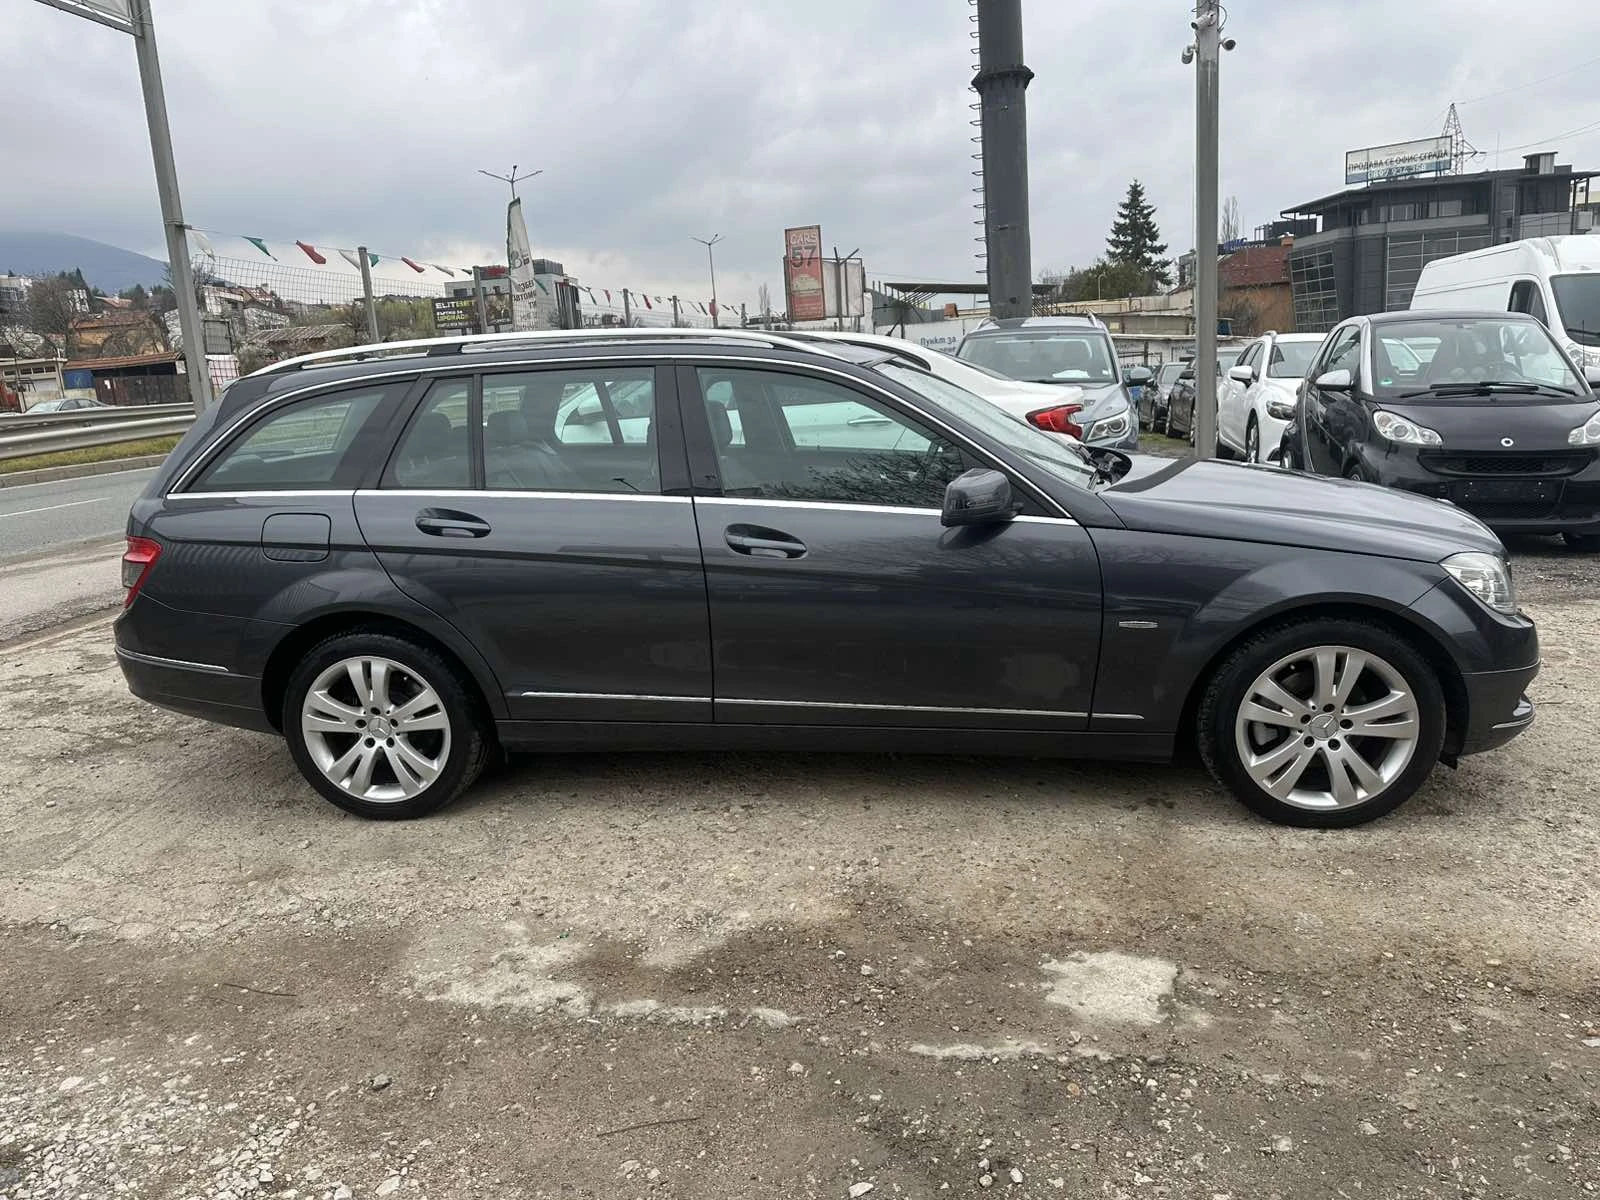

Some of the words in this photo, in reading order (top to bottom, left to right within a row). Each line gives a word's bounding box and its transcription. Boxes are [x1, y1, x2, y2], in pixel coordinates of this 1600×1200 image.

[1348, 160, 1384, 172] ПРОДАВА
[1385, 158, 1394, 166] СЕ
[1394, 155, 1418, 165] ОФИС
[1419, 149, 1449, 162] СГРАДА
[790, 232, 817, 245] CARS
[791, 245, 817, 268] 57
[947, 336, 957, 345] за
